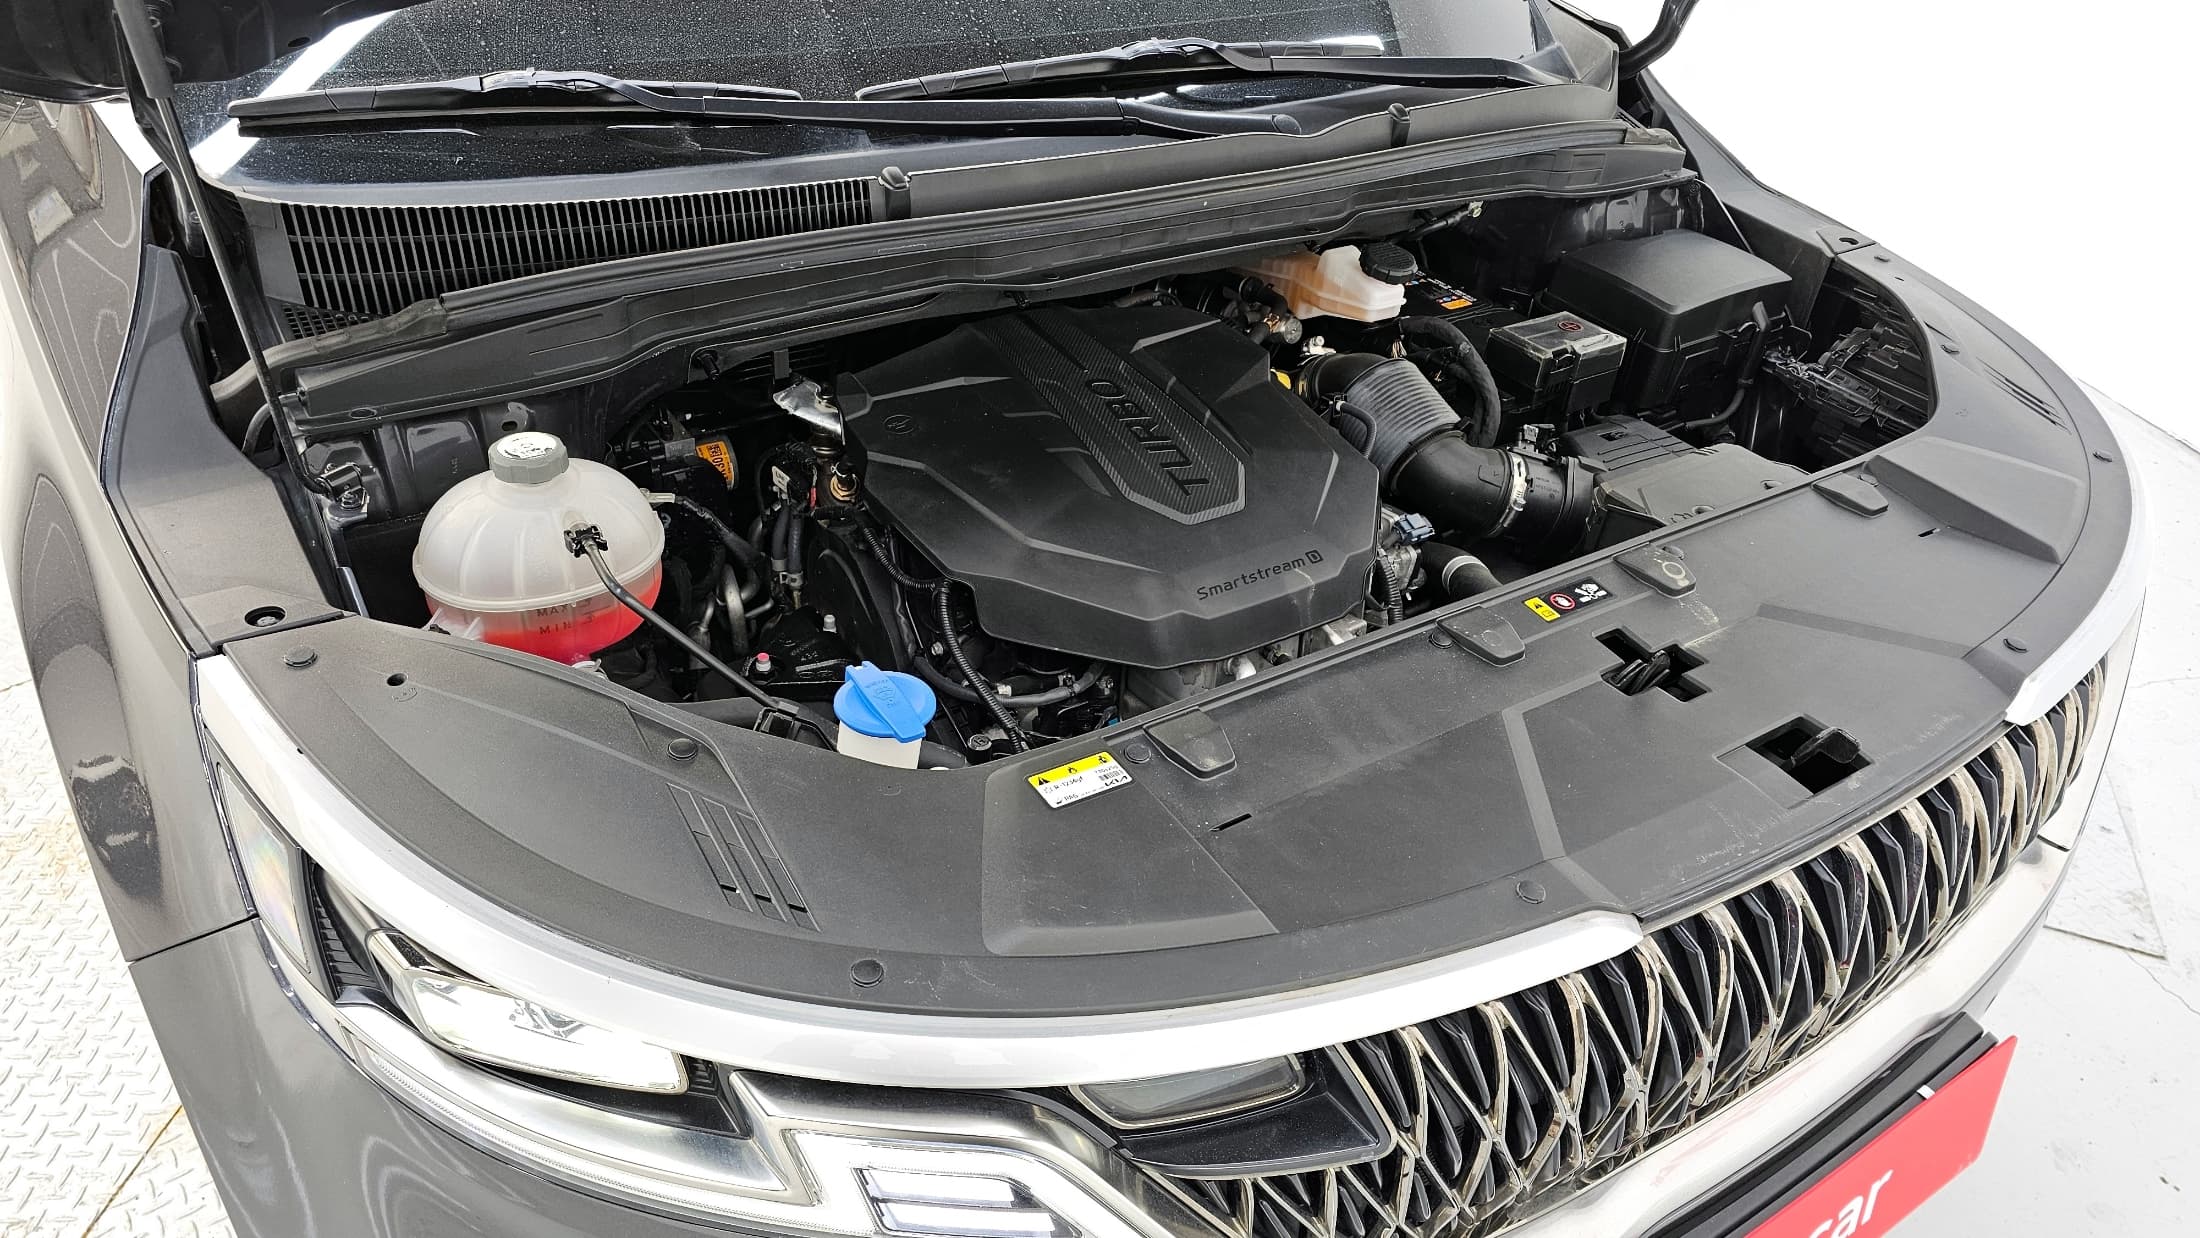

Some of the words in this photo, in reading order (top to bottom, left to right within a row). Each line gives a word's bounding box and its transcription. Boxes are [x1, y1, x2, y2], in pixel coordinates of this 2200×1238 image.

[1089, 381, 1210, 497] TURBO
[1196, 557, 1306, 601] Smartstream
[536, 603, 569, 617] MAX
[539, 621, 571, 635] MIN
[1104, 775, 1128, 787] KIA
